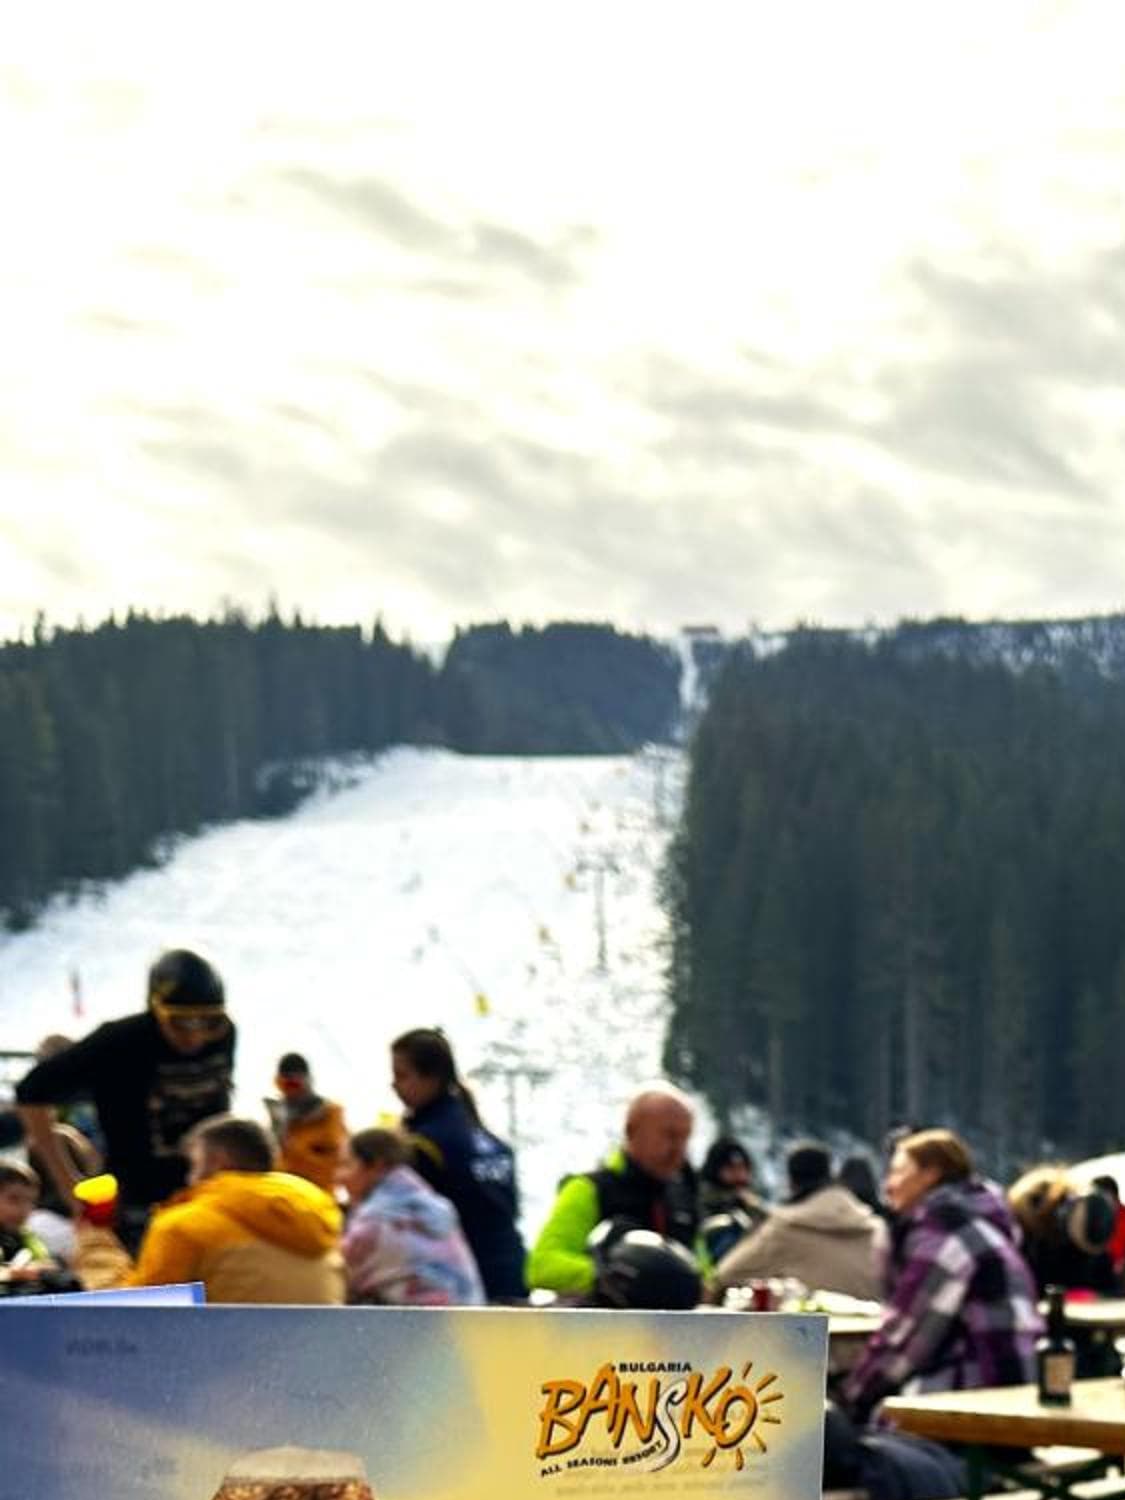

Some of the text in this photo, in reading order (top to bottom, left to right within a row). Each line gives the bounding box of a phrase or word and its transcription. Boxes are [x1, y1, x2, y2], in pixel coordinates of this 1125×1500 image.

[619, 1362, 692, 1373] BULGARIA
[536, 1362, 758, 1472] BANSKO
[540, 1440, 663, 1478] ALL SEASONS RESORT
